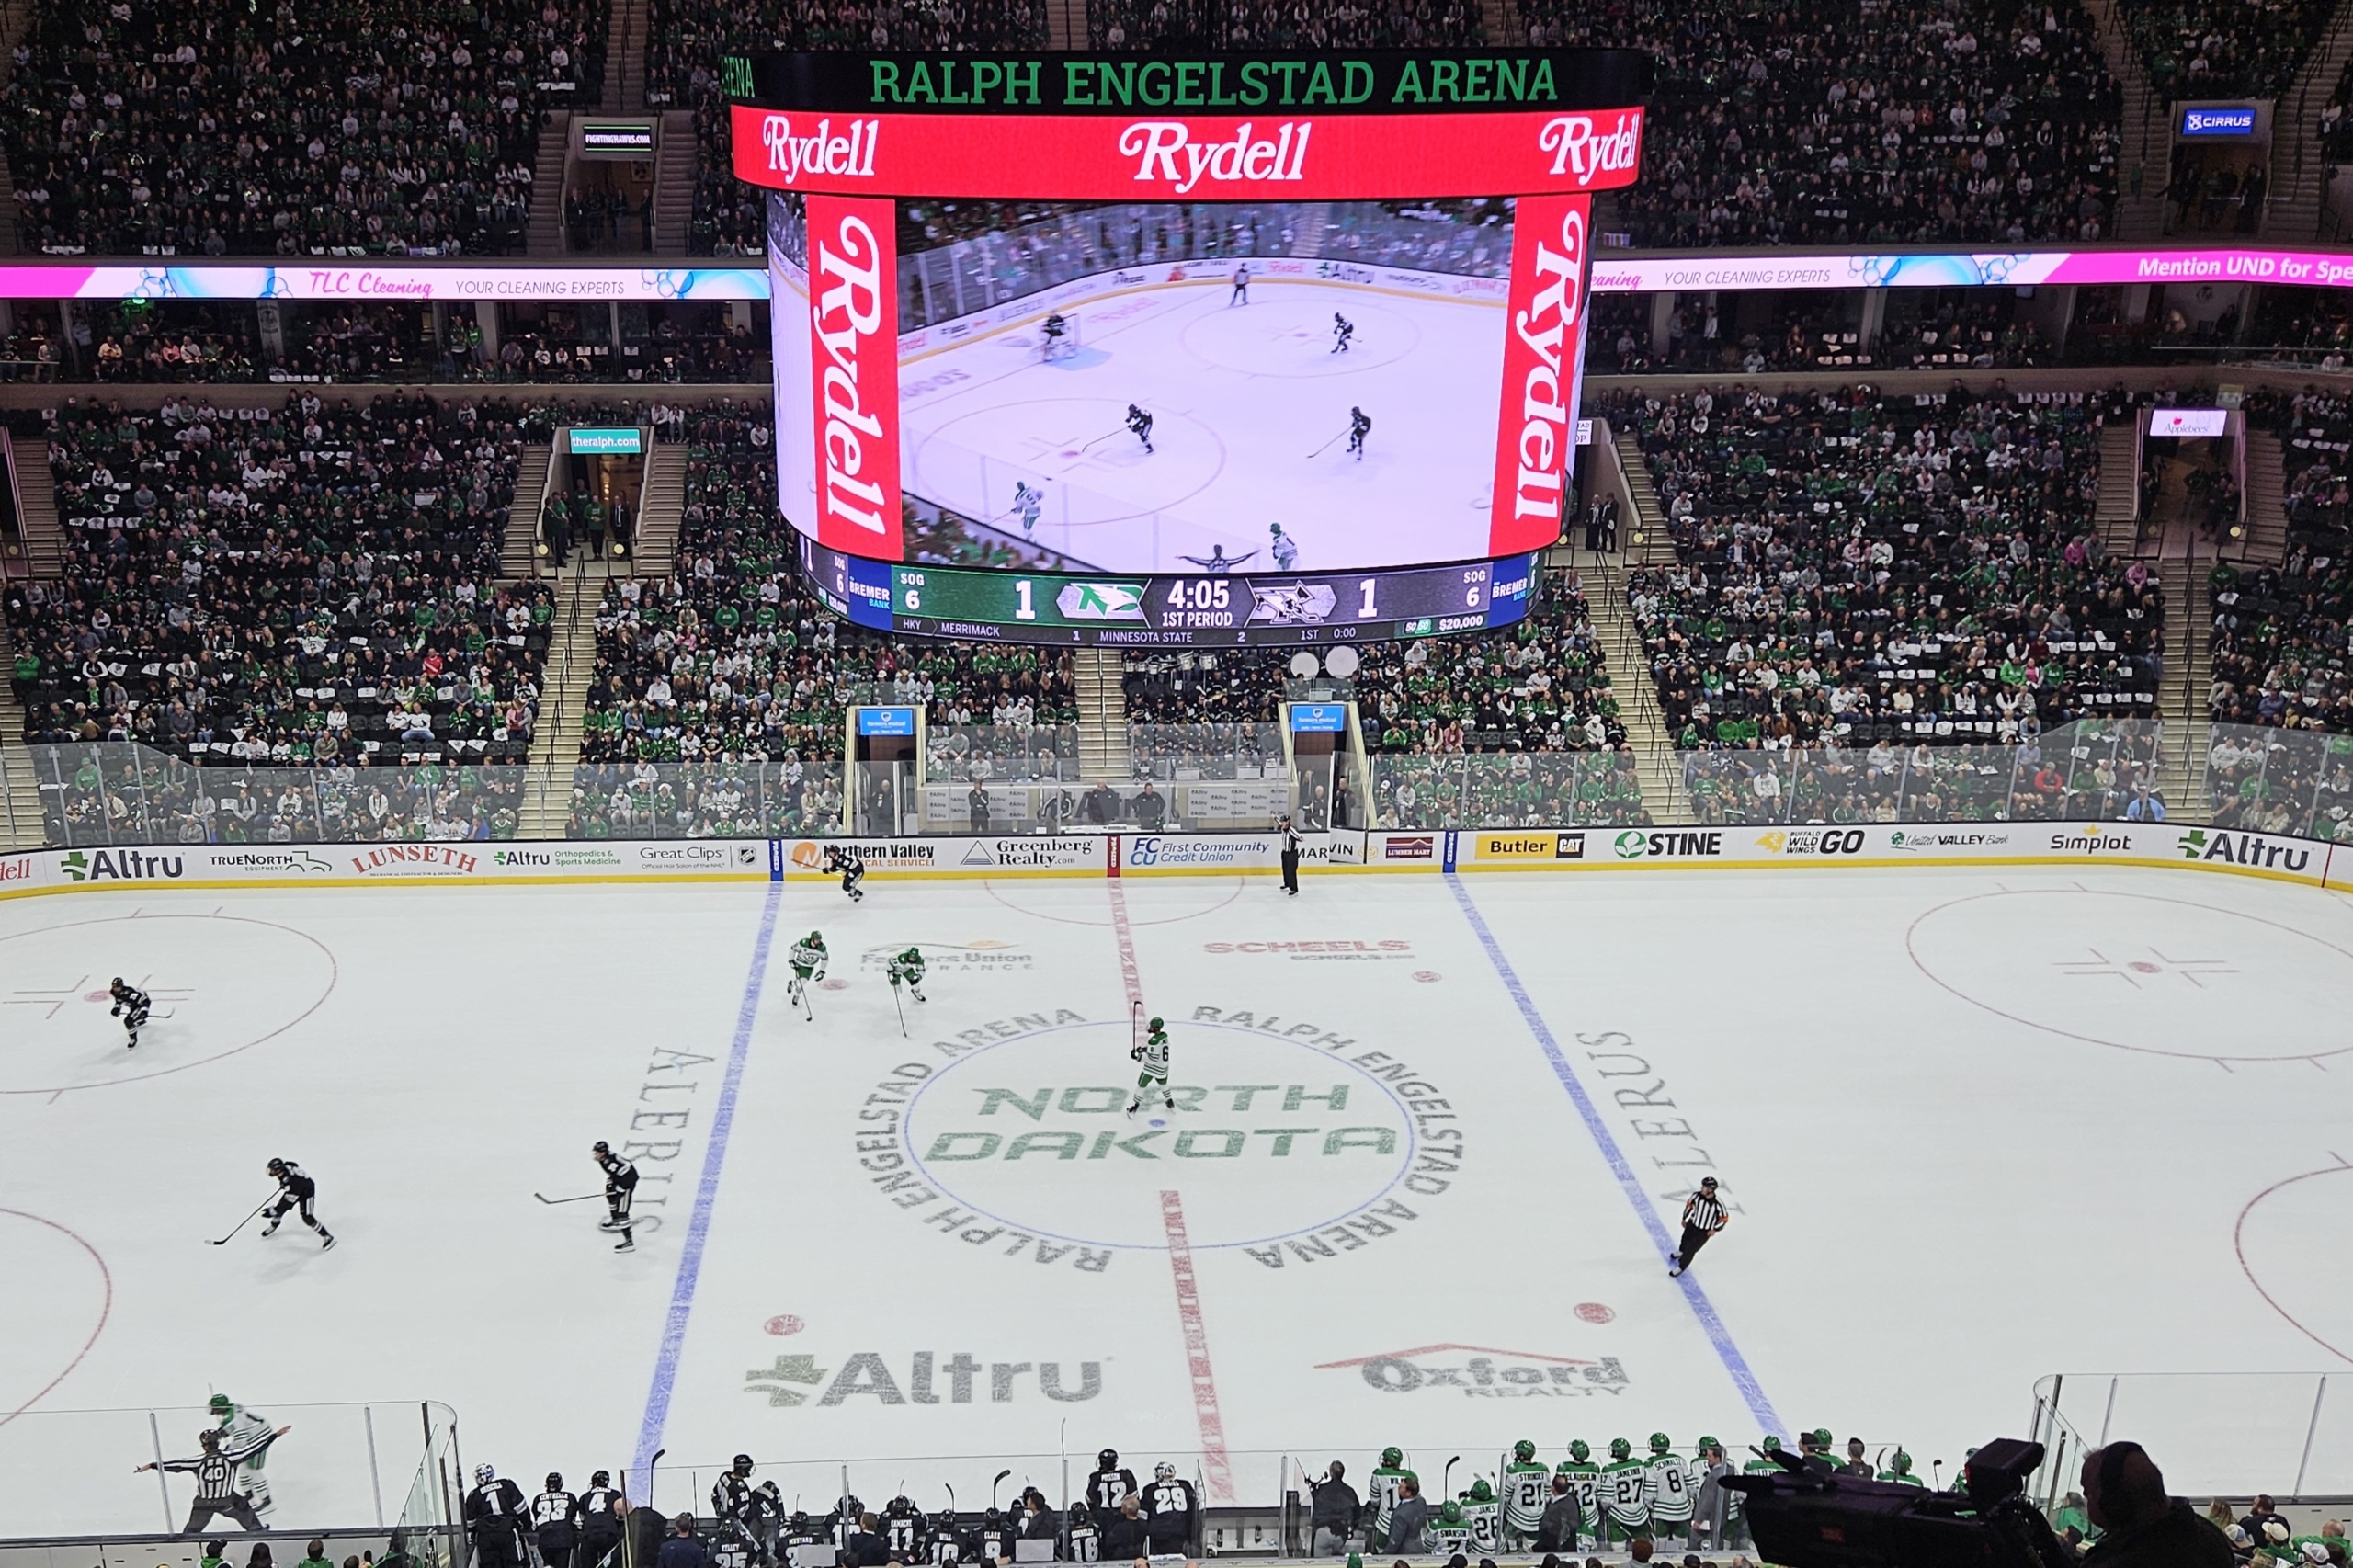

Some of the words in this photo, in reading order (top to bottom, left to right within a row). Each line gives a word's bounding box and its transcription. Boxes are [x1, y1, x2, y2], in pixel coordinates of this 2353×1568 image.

[870, 60, 1042, 105] RALPH
[1063, 61, 1375, 106] ENGELSTAD
[1391, 58, 1559, 103] ARENA
[2202, 116, 2252, 128] CIRRUS
[585, 133, 651, 144] FIGHTINGHAWKS.COM
[762, 115, 880, 185] Rydell
[1118, 121, 1313, 194] Rydell
[1539, 113, 1641, 186] Rydell
[1664, 271, 1701, 286] YOUR
[1704, 270, 1773, 285] CLEANING
[1776, 269, 1832, 284] EXPERTS
[2137, 257, 2221, 277] Mention
[2226, 256, 2275, 276] UND
[2279, 258, 2312, 278] for
[310, 270, 350, 294] TLC
[358, 271, 434, 299] Cleaning
[455, 280, 494, 295] YOUR
[496, 280, 566, 296] CLEANING
[570, 280, 626, 296] EXPERTS
[813, 214, 887, 536] Rydell
[1515, 210, 1584, 520] Rydell
[572, 436, 640, 449] theralph.com
[836, 573, 845, 594] 6
[900, 572, 925, 586] SOG
[1463, 570, 1486, 585] SOG
[1492, 577, 1528, 598] BREMER
[849, 580, 891, 601] BREMER
[904, 590, 920, 611] 6
[1014, 579, 1036, 620] 1
[1167, 579, 1230, 610] 4:05
[1358, 578, 1378, 619] 1
[1466, 586, 1480, 608] 6
[869, 598, 891, 610] BANK
[1162, 611, 1185, 628] 1ST
[1186, 611, 1233, 628] PERIOD
[1438, 616, 1484, 632] $20,000
[903, 619, 922, 631] HKY
[940, 622, 1000, 638] MERRIMACK
[1073, 631, 1081, 642] 1
[1100, 631, 1160, 643] MINNESOTA
[1163, 631, 1193, 644] STATE
[1237, 632, 1246, 643] 2
[1300, 630, 1320, 642] 1ST
[1333, 627, 1358, 640] 0:00
[996, 838, 1093, 857] Greenberg
[1134, 837, 1161, 853] FC
[1162, 843, 1190, 853] First
[1193, 841, 1270, 856] Community
[1489, 838, 1548, 854] Butler
[1558, 838, 1584, 854] CAT
[1647, 832, 1722, 856] STINE
[1789, 837, 1819, 846] WILD
[1819, 830, 1866, 854] GO
[1905, 834, 1938, 846] United
[1938, 835, 1985, 845] VALLEY
[2050, 835, 2131, 854] Simplot
[210, 854, 293, 866] TRUENORTH
[351, 845, 478, 873] LUNSETH
[506, 850, 551, 865] Altru
[554, 850, 606, 859] Orthopedics
[640, 847, 684, 859] Great
[687, 846, 722, 861] Clips
[890, 844, 935, 858] Valley
[1130, 852, 1157, 866] CU
[1160, 852, 1203, 862] Credit
[1207, 851, 1234, 862] Union
[2202, 832, 2310, 872] Altru
[90, 849, 184, 881] Altru
[554, 858, 583, 867] Sports
[965, 952, 1033, 963] Union
[1202, 940, 1412, 954] SCHEELS
[932, 1008, 1088, 1058] ARENA
[1191, 1006, 1357, 1051] RALPH
[1163, 1045, 1169, 1062] 6
[971, 1084, 1351, 1121] NORTH
[1350, 1051, 1464, 1196] ENGELSTAD
[855, 1062, 940, 1209] ENGELSTAD
[923, 1126, 1397, 1162] DAKOTA
[923, 1206, 1113, 1273] RALPH
[1242, 1198, 1419, 1269] ARENA
[815, 1350, 1102, 1407] Altru
[1361, 1355, 1631, 1393] Oxford
[1463, 1386, 1628, 1398] REALTY
[204, 1466, 224, 1482] 40
[1566, 1472, 1597, 1482] cLAUGHLIN
[1666, 1469, 1682, 1494] 8
[1097, 1481, 1128, 1509] 12
[1154, 1487, 1188, 1515] 29
[1521, 1483, 1544, 1507] 21
[1617, 1478, 1643, 1505] 27
[485, 1490, 504, 1515] 1
[537, 1499, 569, 1526] 23
[588, 1493, 607, 1514] 4
[1478, 1505, 1495, 1515] JAMES
[887, 1528, 914, 1551] 11
[1440, 1528, 1467, 1539] SWANSON
[930, 1541, 959, 1567] 10
[1447, 1540, 1461, 1554] 7
